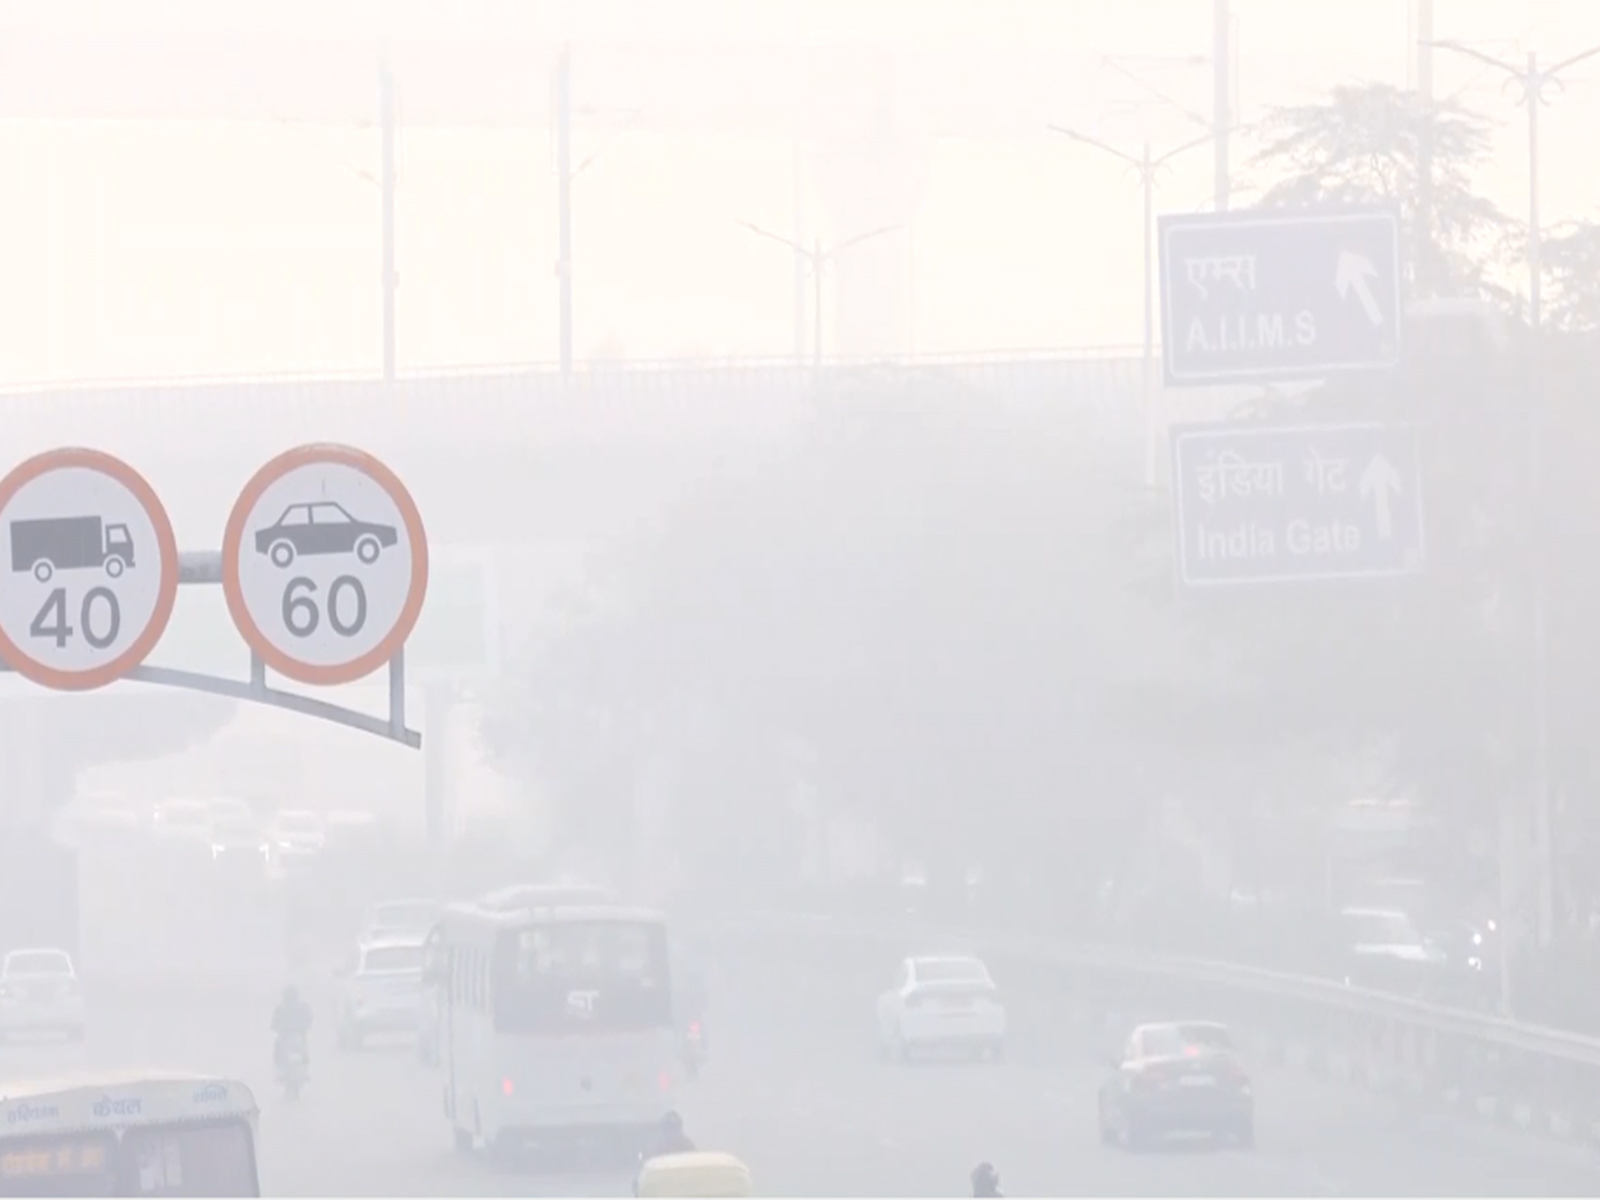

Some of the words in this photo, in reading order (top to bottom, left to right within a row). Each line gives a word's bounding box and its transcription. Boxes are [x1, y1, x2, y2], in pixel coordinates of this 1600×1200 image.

[1185, 254, 1256, 299] एम्स
[1186, 310, 1317, 352] A.I.I.M.S
[1196, 446, 1283, 502] इंडिया
[1303, 443, 1350, 496] गेट
[1198, 521, 1275, 560] India
[1286, 518, 1361, 555] Gate
[29, 586, 122, 649] 40
[281, 575, 368, 638] 60
